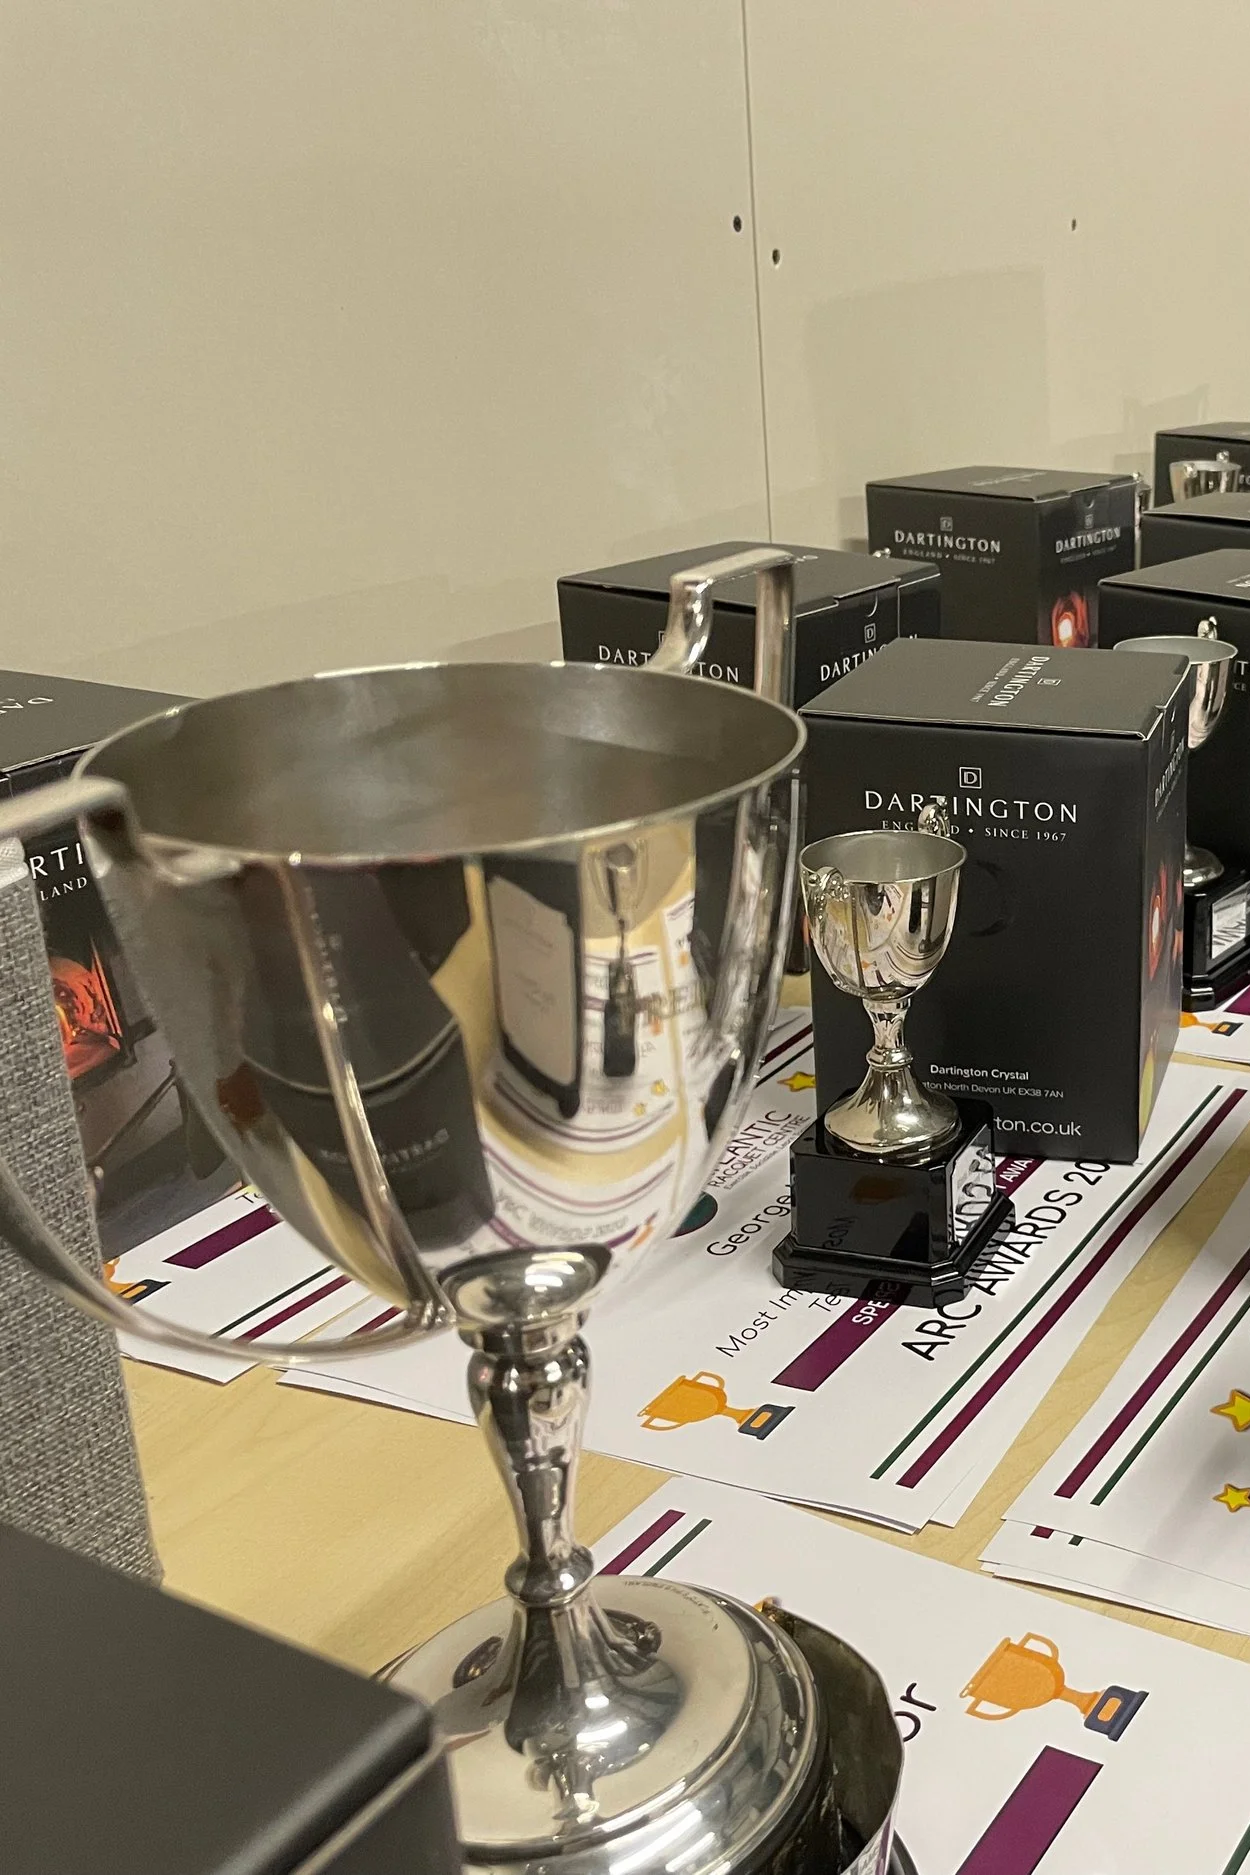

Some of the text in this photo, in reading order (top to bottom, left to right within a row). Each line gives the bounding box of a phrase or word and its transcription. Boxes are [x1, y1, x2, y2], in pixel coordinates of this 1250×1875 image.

[895, 530, 1000, 553] DARTINGTON
[1055, 527, 1121, 553] DARTINGTON
[598, 645, 739, 683] DARTTON
[987, 656, 1050, 707] DARTINGTON
[882, 820, 1067, 842] ENGD SINCE 1967
[41, 876, 88, 901] LAND
[930, 1064, 1029, 1081] Dartington Crystal
[944, 1081, 969, 1091] North
[1002, 1087, 1016, 1095] UK
[1044, 1090, 1064, 1098] 7AN
[719, 1110, 792, 1166] LANTIC
[707, 1145, 766, 1188] RACQUET
[901, 1304, 982, 1361] ARC
[970, 1189, 1084, 1296] AWARDS
[1063, 1160, 1111, 1186] 20
[715, 1310, 778, 1358] Most
